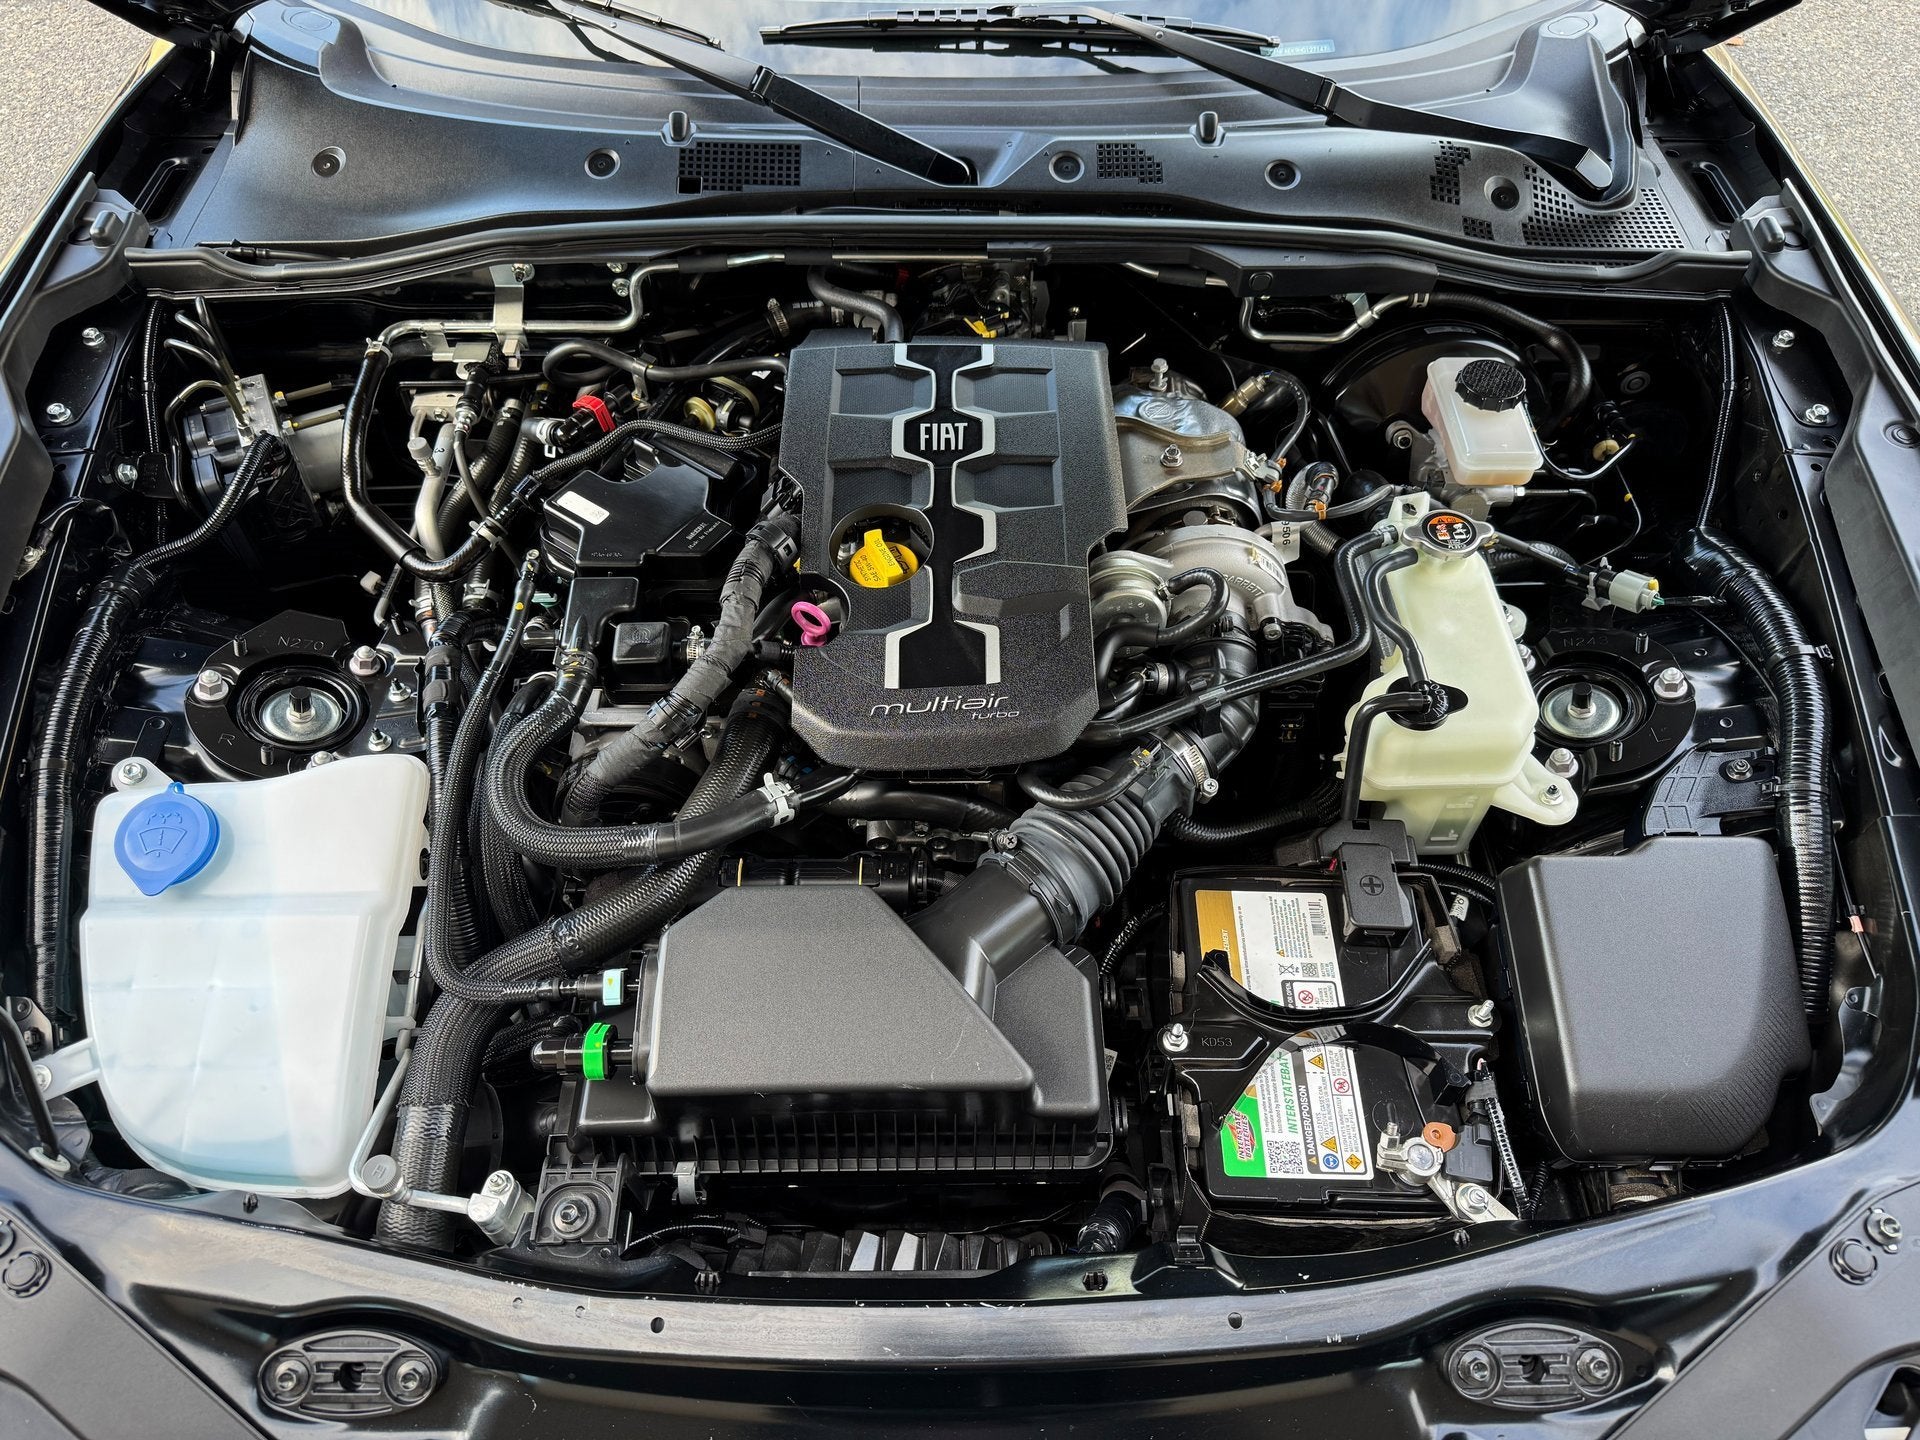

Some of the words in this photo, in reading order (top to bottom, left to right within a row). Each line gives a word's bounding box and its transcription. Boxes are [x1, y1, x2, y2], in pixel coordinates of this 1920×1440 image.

[920, 423, 968, 451] FIAT
[874, 538, 883, 548] OIL
[879, 548, 896, 567] ENGINE
[277, 635, 325, 652] N270
[870, 693, 1009, 717] multiair
[972, 711, 1020, 720] turbo
[1201, 1037, 1233, 1047] KD53
[1298, 1085, 1316, 1155] DANGER/POISON
[1235, 1112, 1245, 1159] INTERSTATE
[1241, 1115, 1252, 1157] BATTERIES
